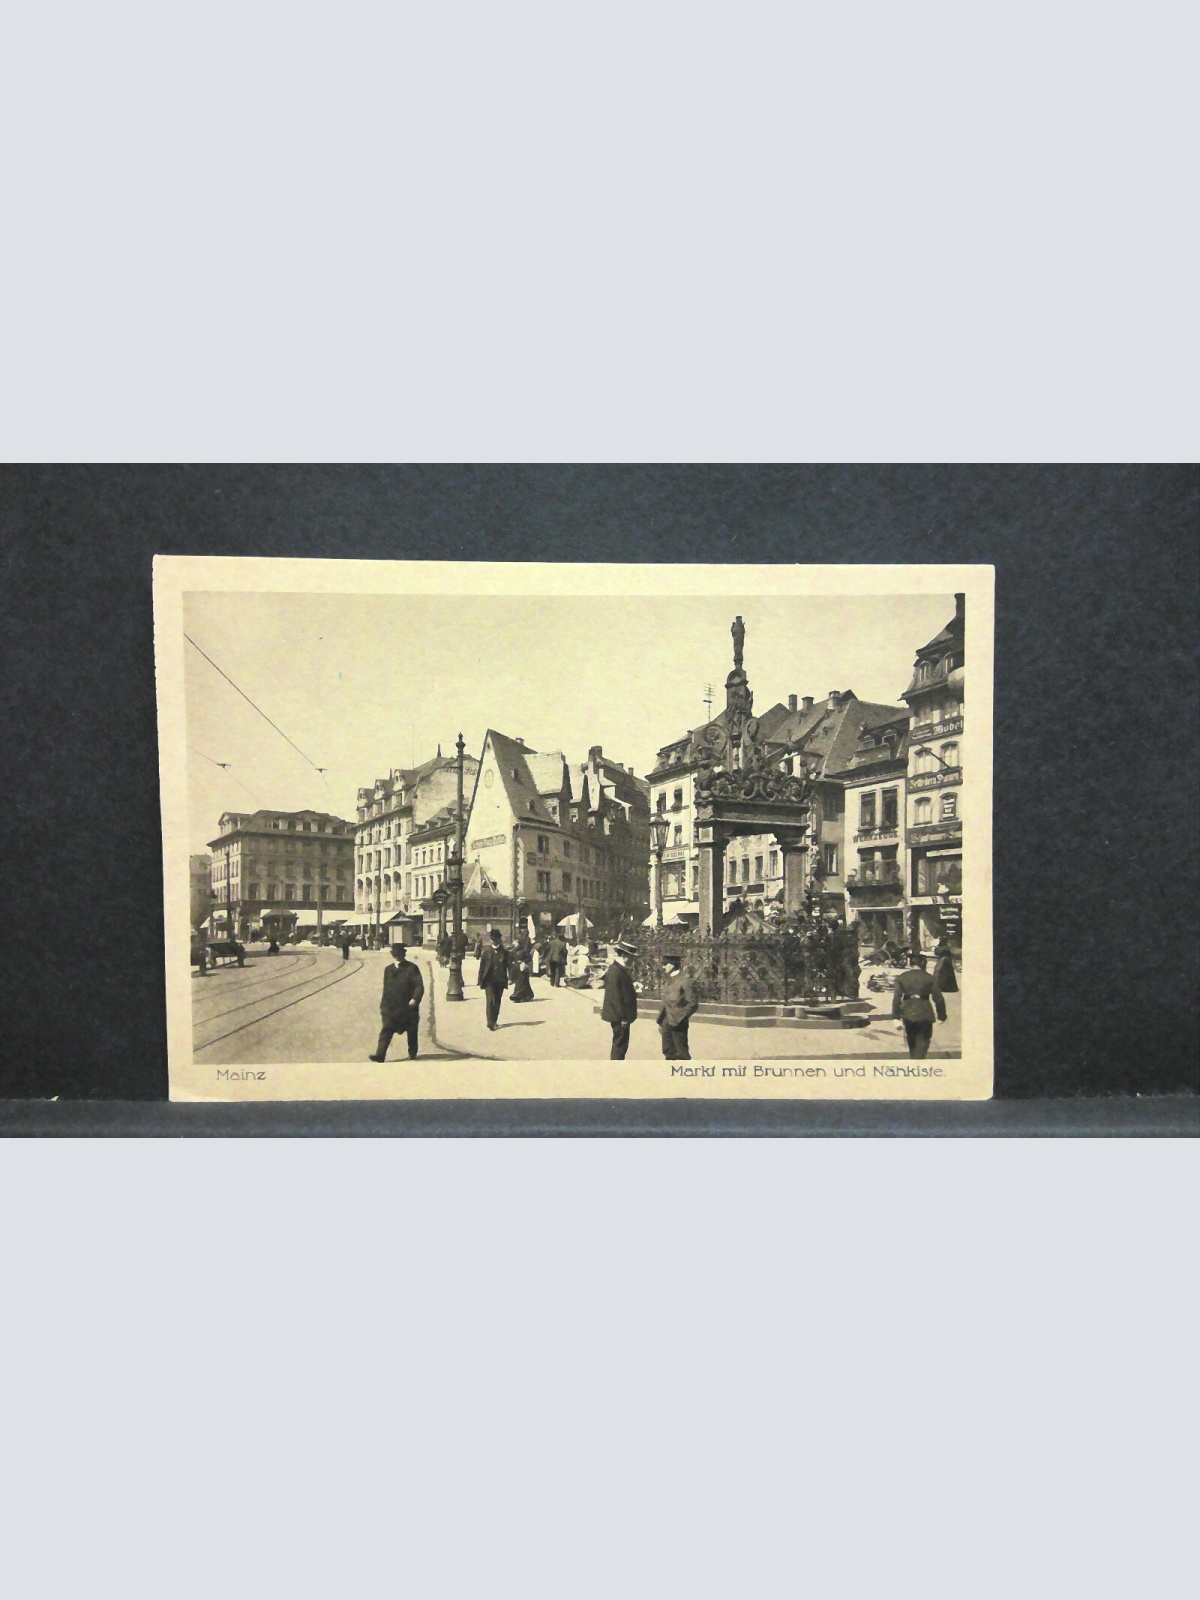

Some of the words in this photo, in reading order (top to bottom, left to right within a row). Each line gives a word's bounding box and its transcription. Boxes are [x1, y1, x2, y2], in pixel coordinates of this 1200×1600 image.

[216, 1068, 266, 1081] Mainz
[670, 1065, 715, 1077] Markt
[722, 1065, 747, 1077] mit
[753, 1065, 826, 1077] Brunnen
[833, 1065, 866, 1077] und
[872, 1065, 947, 1077] Nähkiste.
